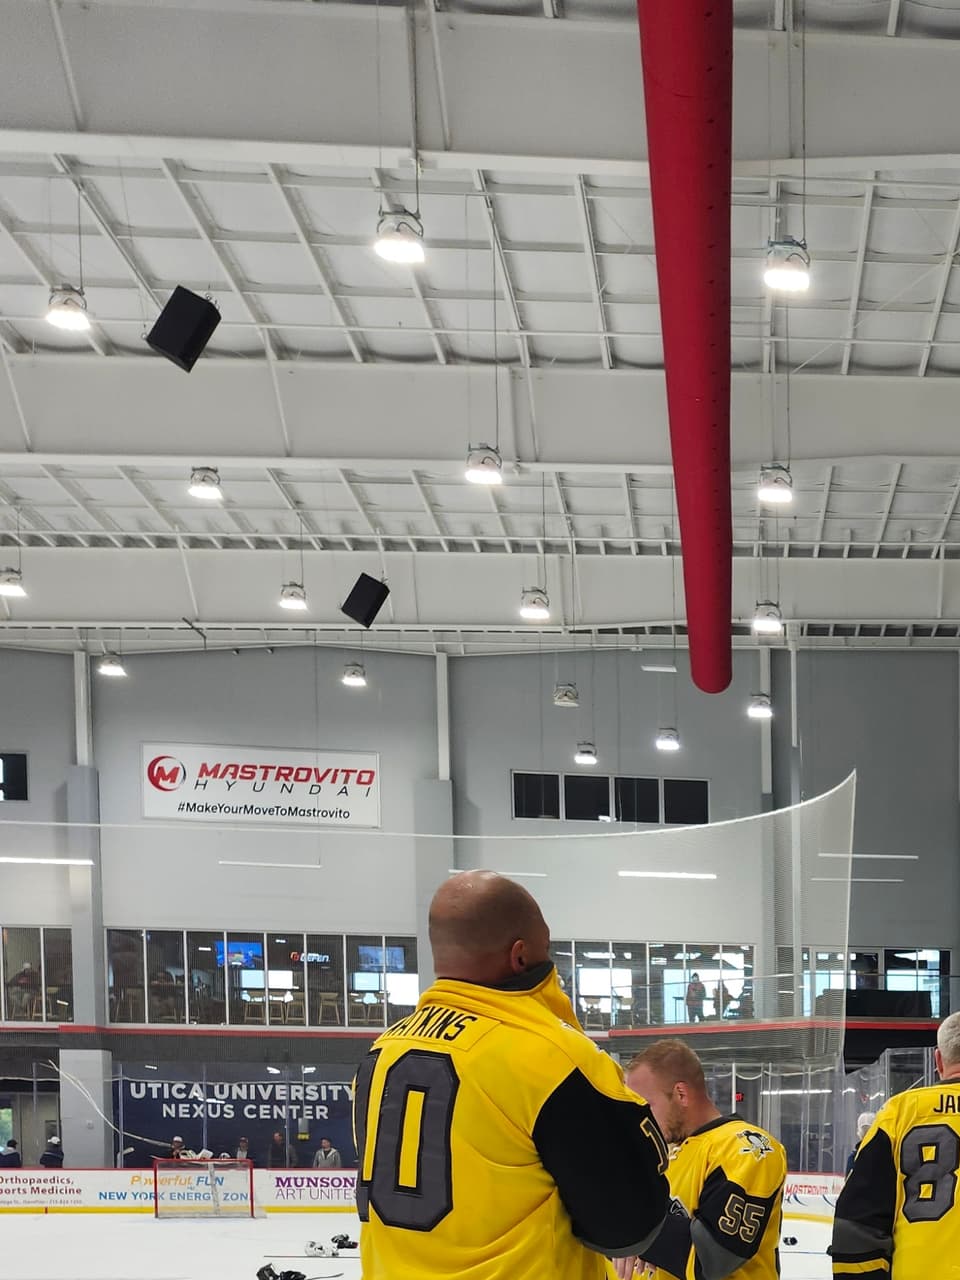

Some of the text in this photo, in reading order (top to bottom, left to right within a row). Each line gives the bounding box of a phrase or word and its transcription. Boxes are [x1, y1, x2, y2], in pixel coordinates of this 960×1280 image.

[197, 762, 376, 786] MASTROVITO
[194, 779, 371, 797] HYUNDAI
[177, 801, 351, 819] #MakeYourMoveToMastrovito
[129, 1082, 355, 1101] UTICA UNIVERSITY
[162, 1103, 329, 1120] NEXUS CENTER
[130, 1175, 193, 1187] Pwerful
[274, 1176, 356, 1188] MUNSON
[0, 1186, 82, 1195] orts Medicine
[99, 1191, 249, 1201] NEW YORK ENERG ZON
[275, 1188, 305, 1200] ART
[718, 1193, 766, 1244] 55
